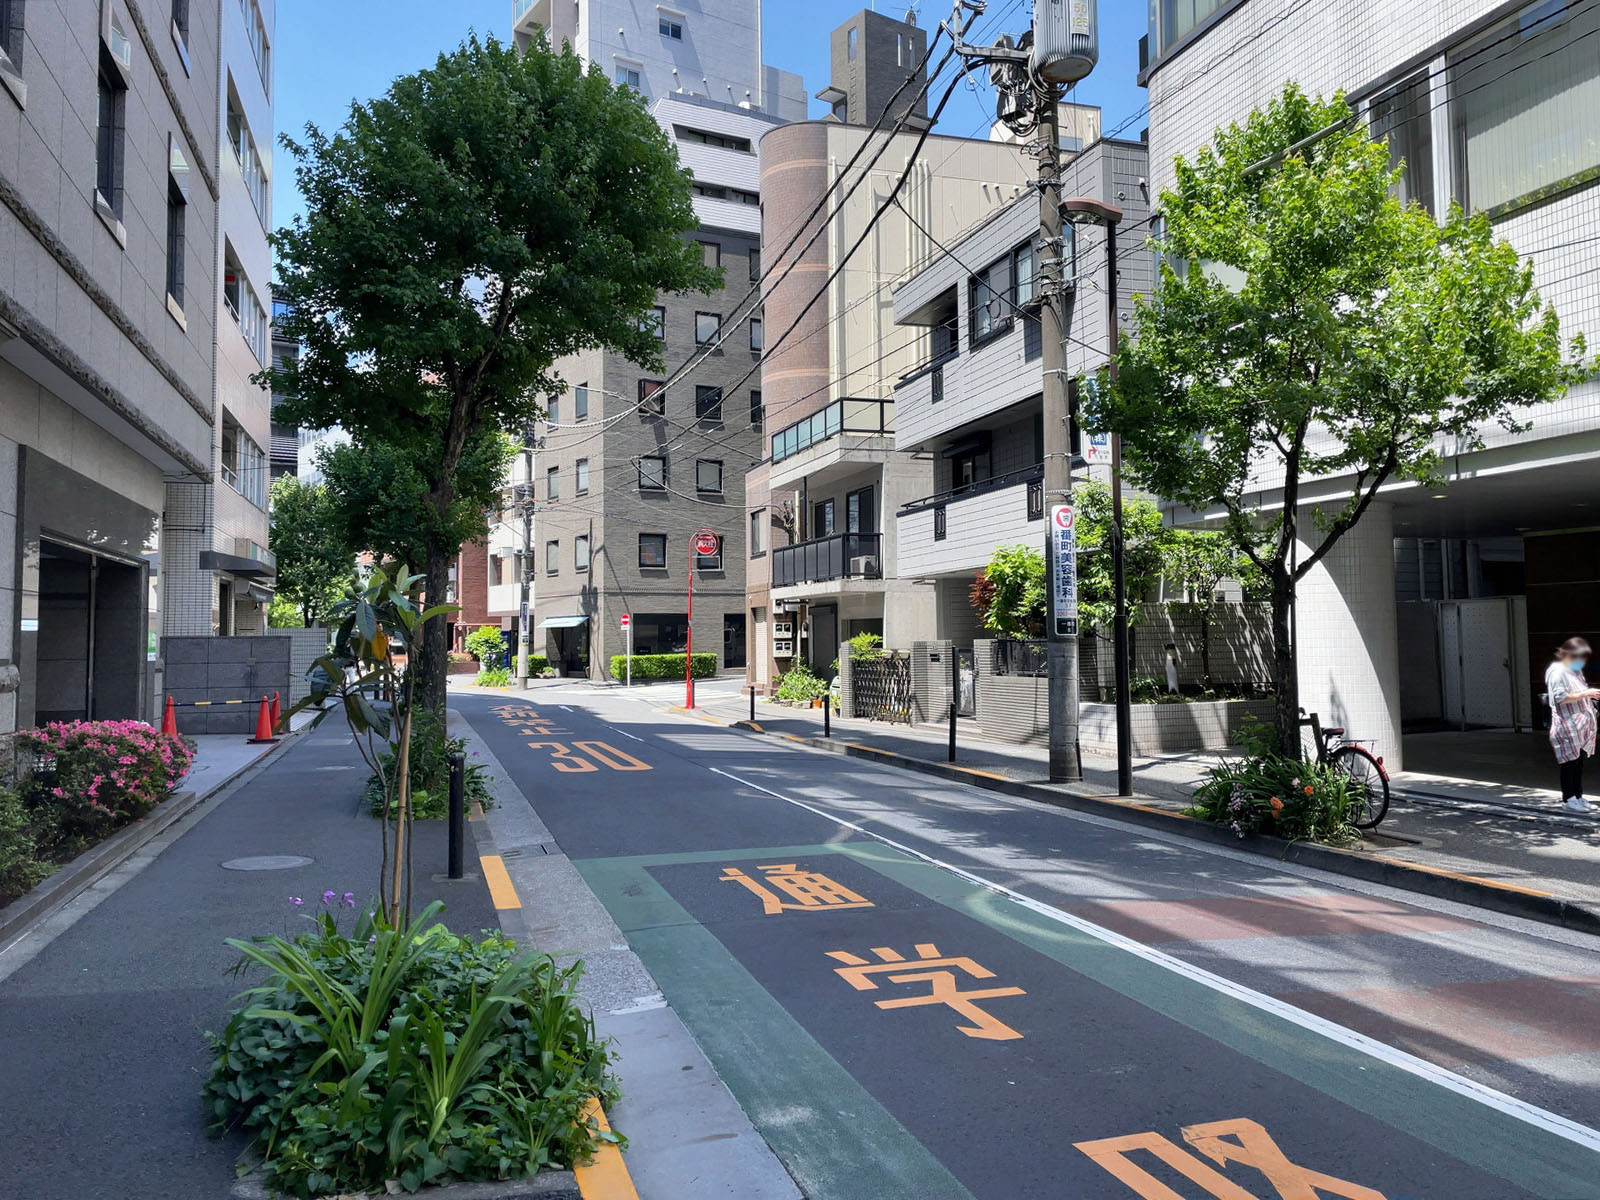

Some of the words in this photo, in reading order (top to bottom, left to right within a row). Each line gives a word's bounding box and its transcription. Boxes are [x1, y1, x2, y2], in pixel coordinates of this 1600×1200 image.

[1060, 529, 1073, 598] 番町美容歯科
[528, 741, 654, 773] 30
